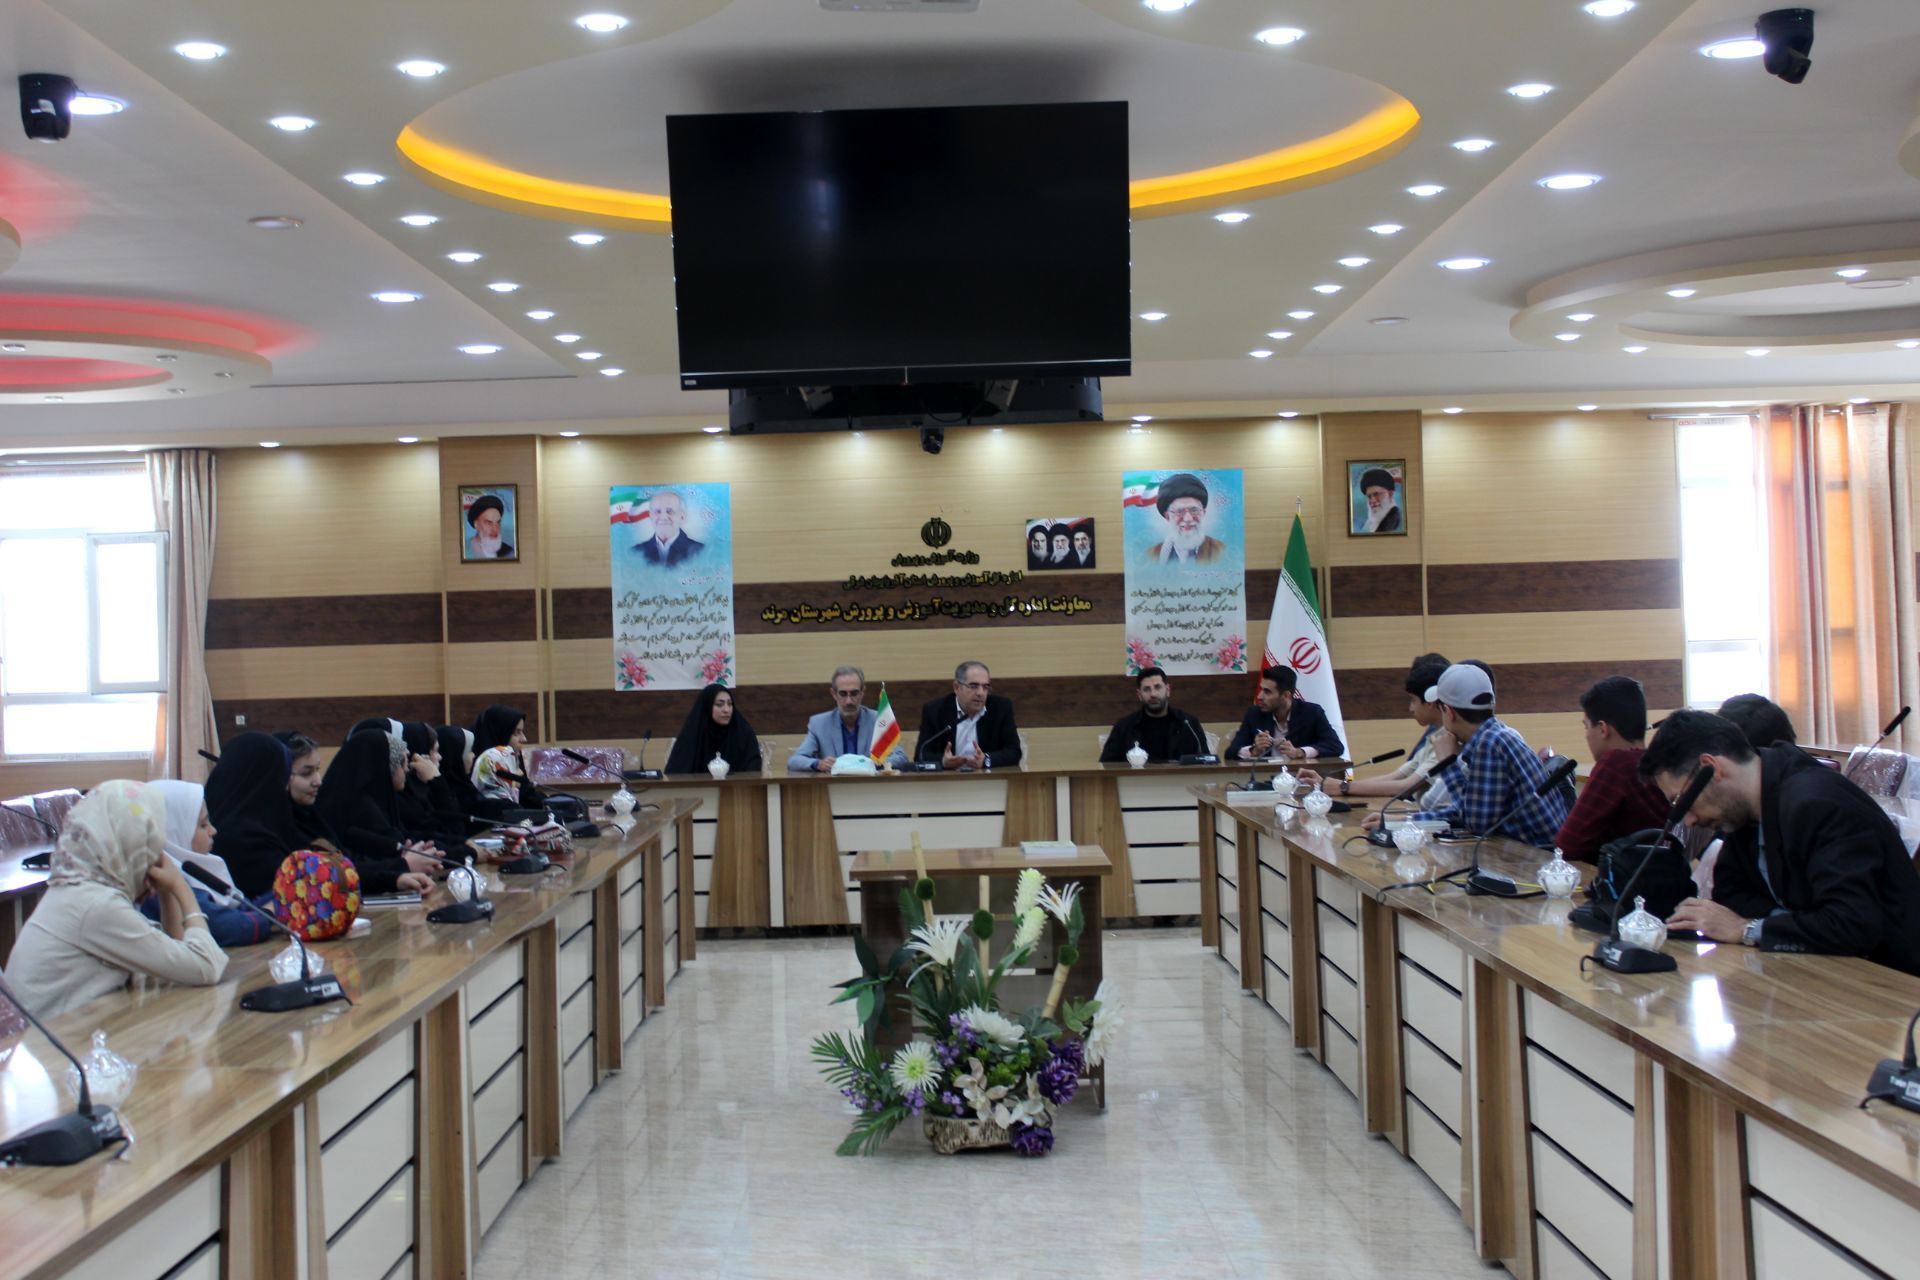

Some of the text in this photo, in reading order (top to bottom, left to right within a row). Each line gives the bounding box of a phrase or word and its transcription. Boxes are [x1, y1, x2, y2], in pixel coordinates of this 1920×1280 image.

[761, 603, 788, 625] مرند
[789, 602, 841, 624] شهرستان
[842, 602, 885, 622] پرورش
[886, 607, 895, 620] و
[895, 597, 942, 620] آموزش
[942, 601, 987, 620] مدیریت
[1048, 596, 1093, 616] معاونت
